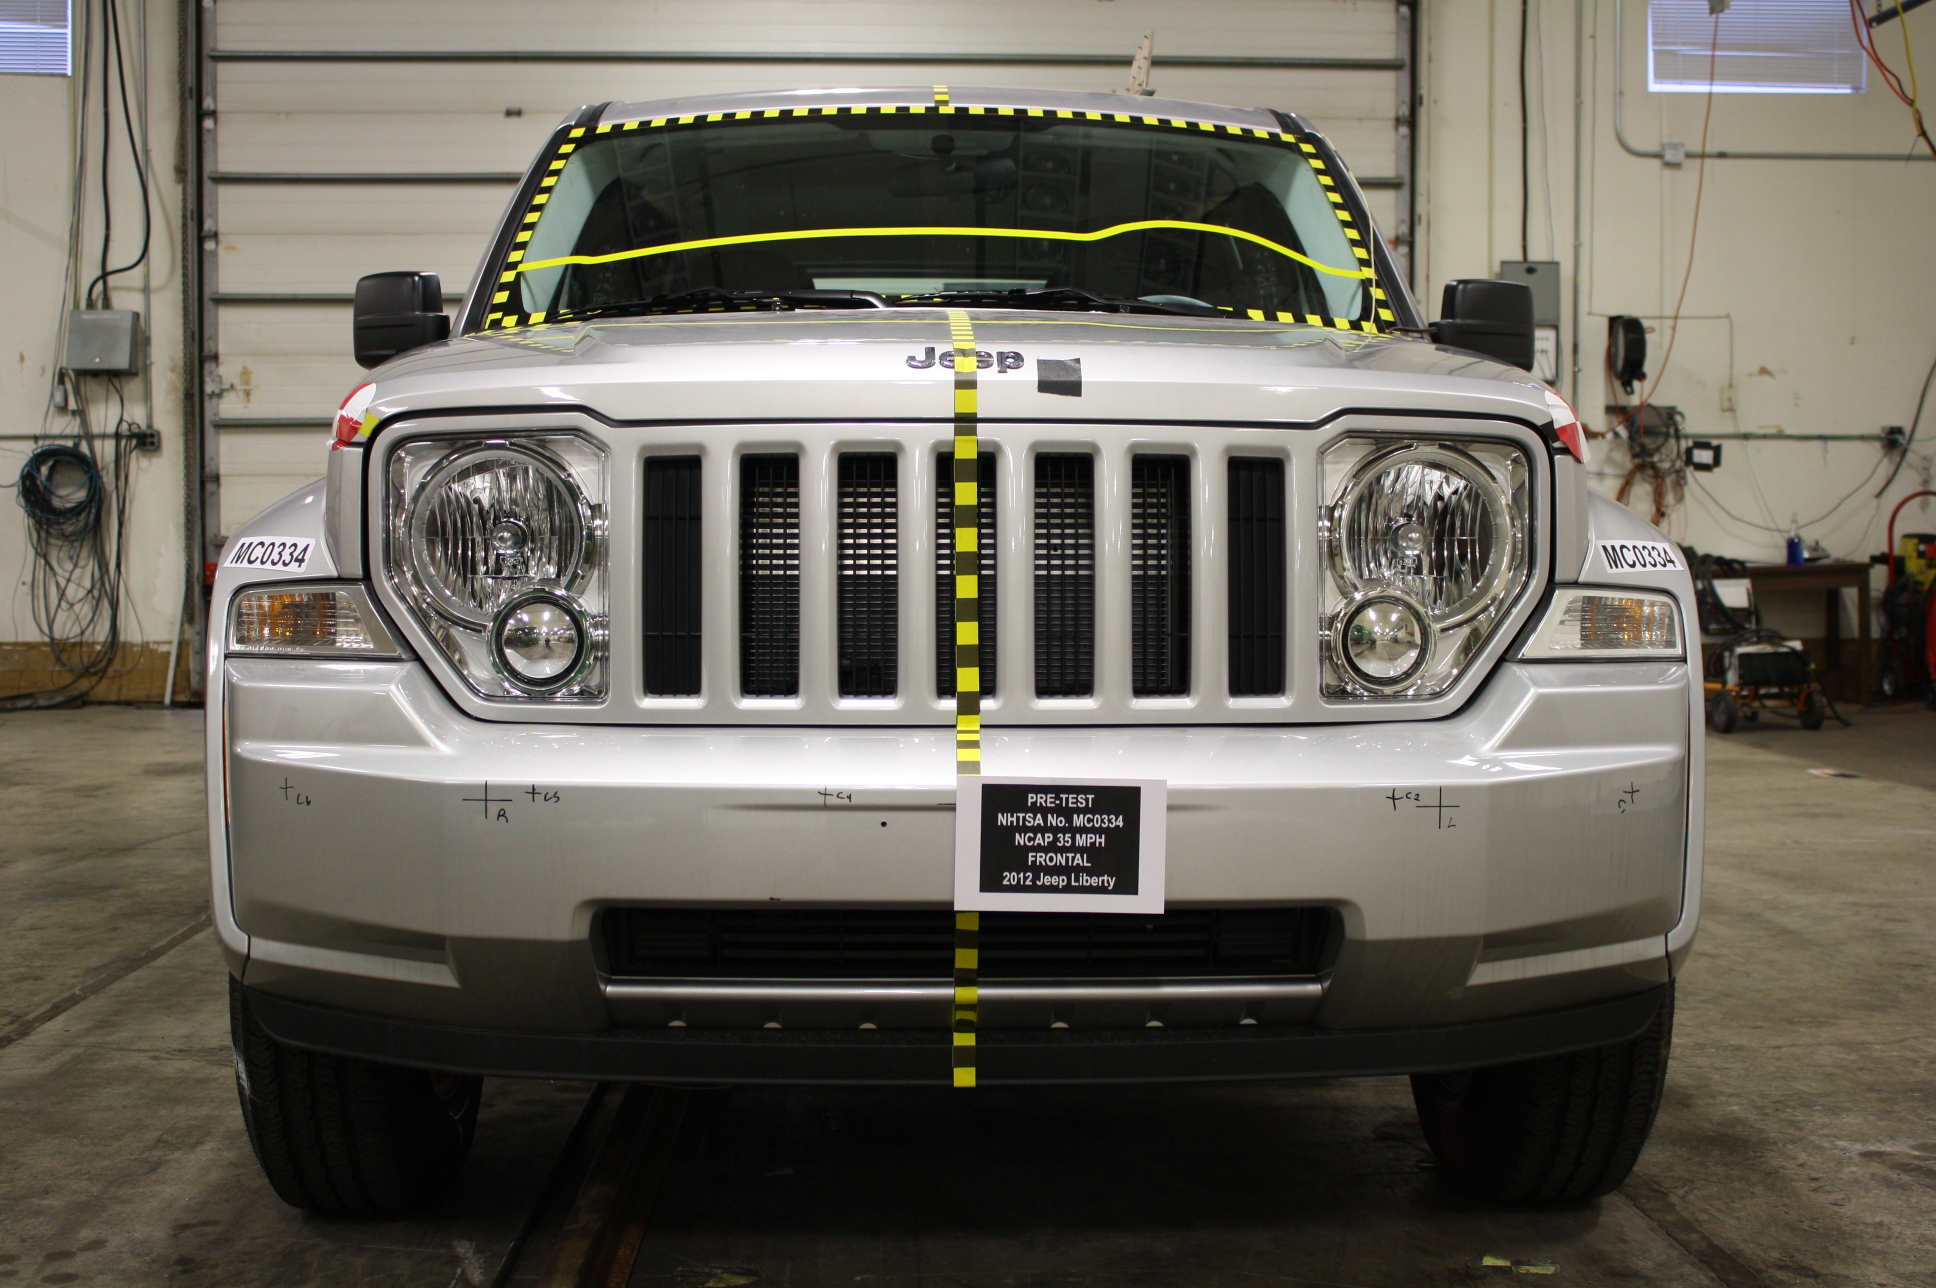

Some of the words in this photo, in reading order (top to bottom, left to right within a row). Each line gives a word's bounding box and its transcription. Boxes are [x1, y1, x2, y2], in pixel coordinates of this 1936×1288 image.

[230, 541, 310, 568] MC0334
[1601, 544, 1677, 569] MC0334
[1027, 793, 1095, 808] PRE-TEST
[497, 808, 508, 823] R
[997, 813, 1044, 827] NHTSA
[1047, 814, 1069, 827] No.
[1072, 814, 1124, 828] MC0334
[1015, 833, 1053, 846] NCAP
[1056, 833, 1072, 847] 35
[1075, 834, 1105, 847] MPH
[1028, 852, 1092, 867] FRONTAL
[1002, 872, 1033, 885] 2012
[1036, 873, 1067, 888] Jeep
[1071, 873, 1116, 889] Liberty
